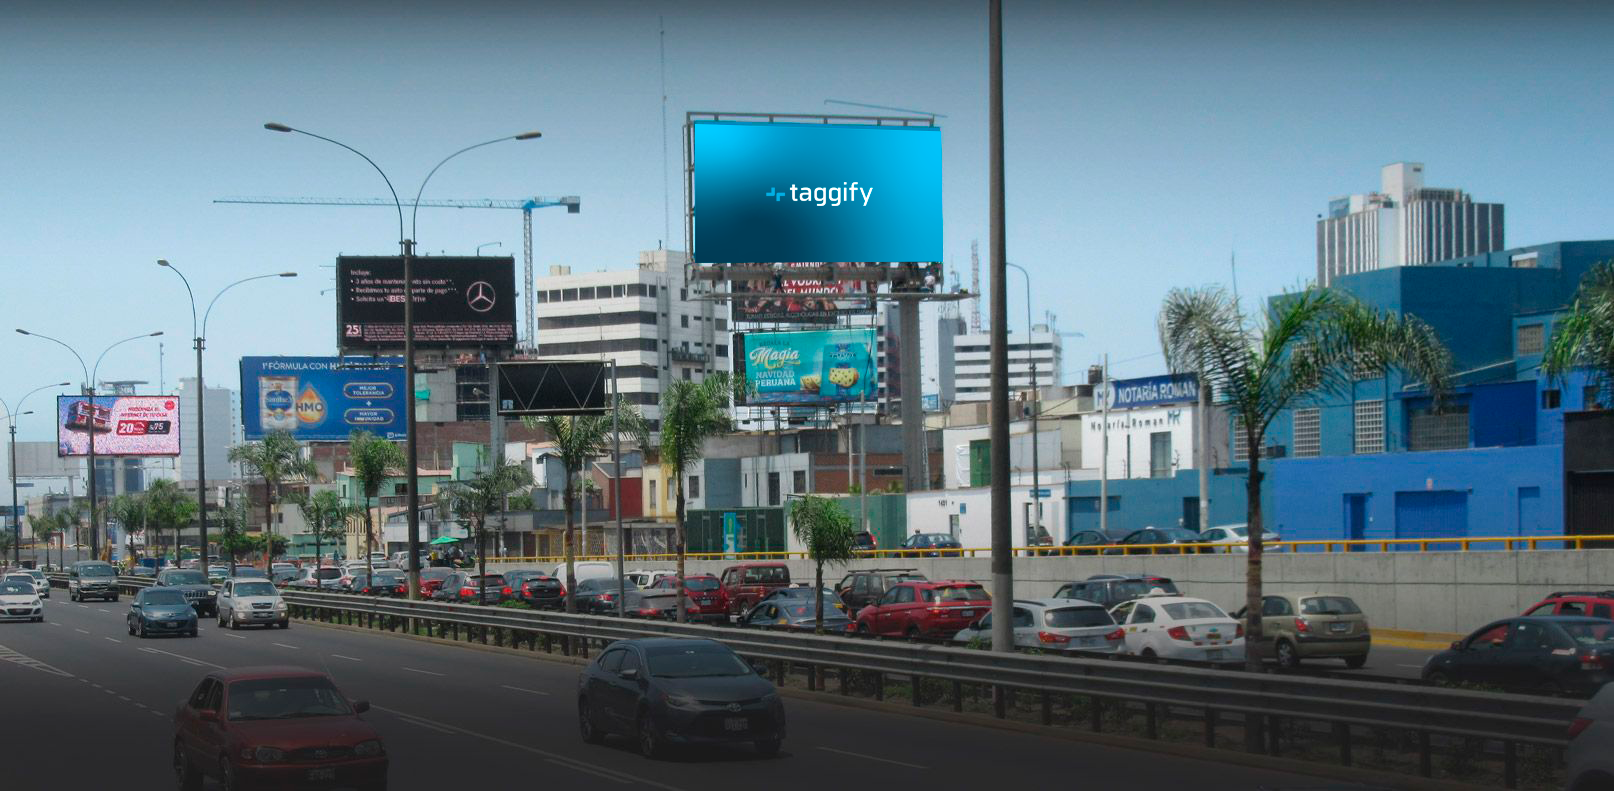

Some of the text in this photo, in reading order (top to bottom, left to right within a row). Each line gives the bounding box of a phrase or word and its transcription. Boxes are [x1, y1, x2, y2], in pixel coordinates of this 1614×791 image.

[790, 182, 873, 206] taggify
[749, 347, 800, 368] Magia
[269, 360, 308, 370] FÓRMULA
[309, 362, 328, 370] CON
[756, 370, 795, 379] NAVIDAD
[756, 378, 796, 387] PERUANA
[1119, 382, 1158, 403] NOTARÍA
[296, 401, 323, 412] HMO
[119, 423, 134, 434] 20
[1091, 420, 1124, 430] Noaría
[1132, 417, 1163, 427] Roman
